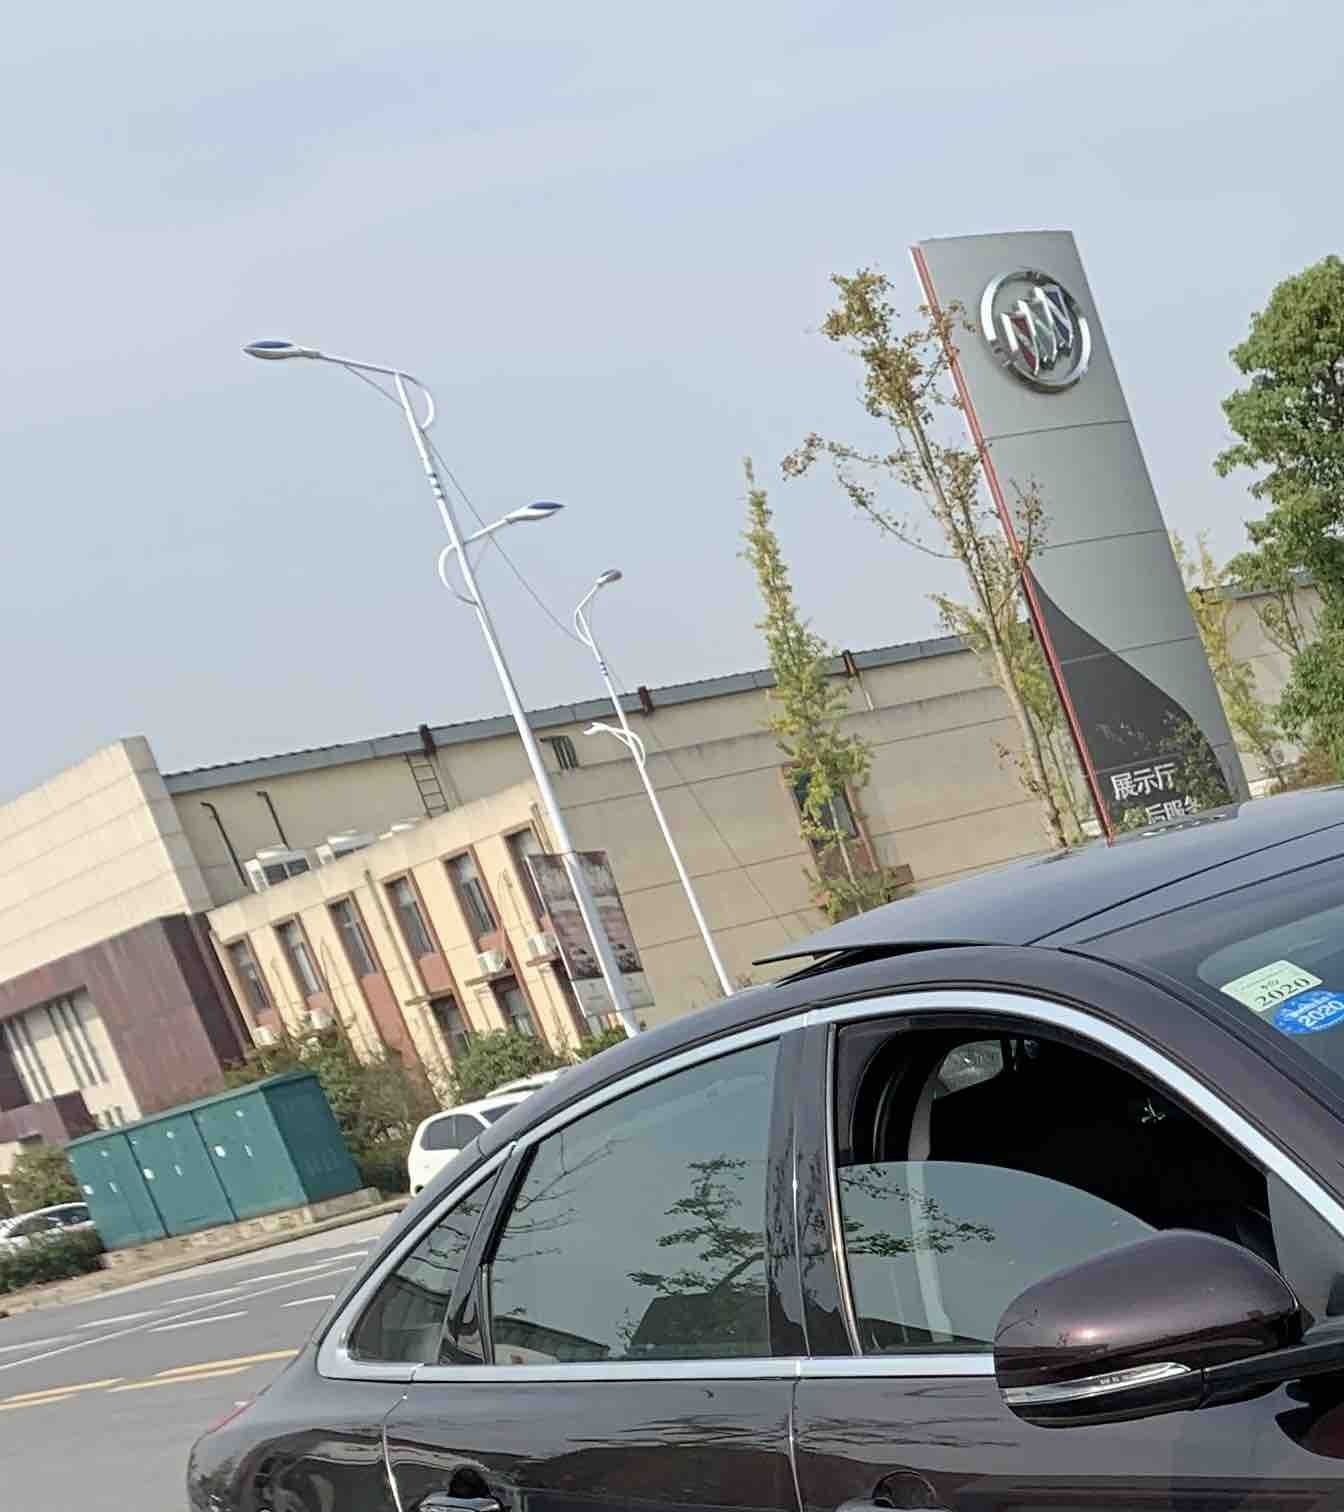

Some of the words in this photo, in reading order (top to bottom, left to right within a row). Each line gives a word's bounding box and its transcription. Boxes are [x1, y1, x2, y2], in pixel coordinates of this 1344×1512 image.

[1110, 762, 1176, 801] 展示厅
[1254, 977, 1311, 1007] 2020
[1298, 999, 1344, 1028] 2020
